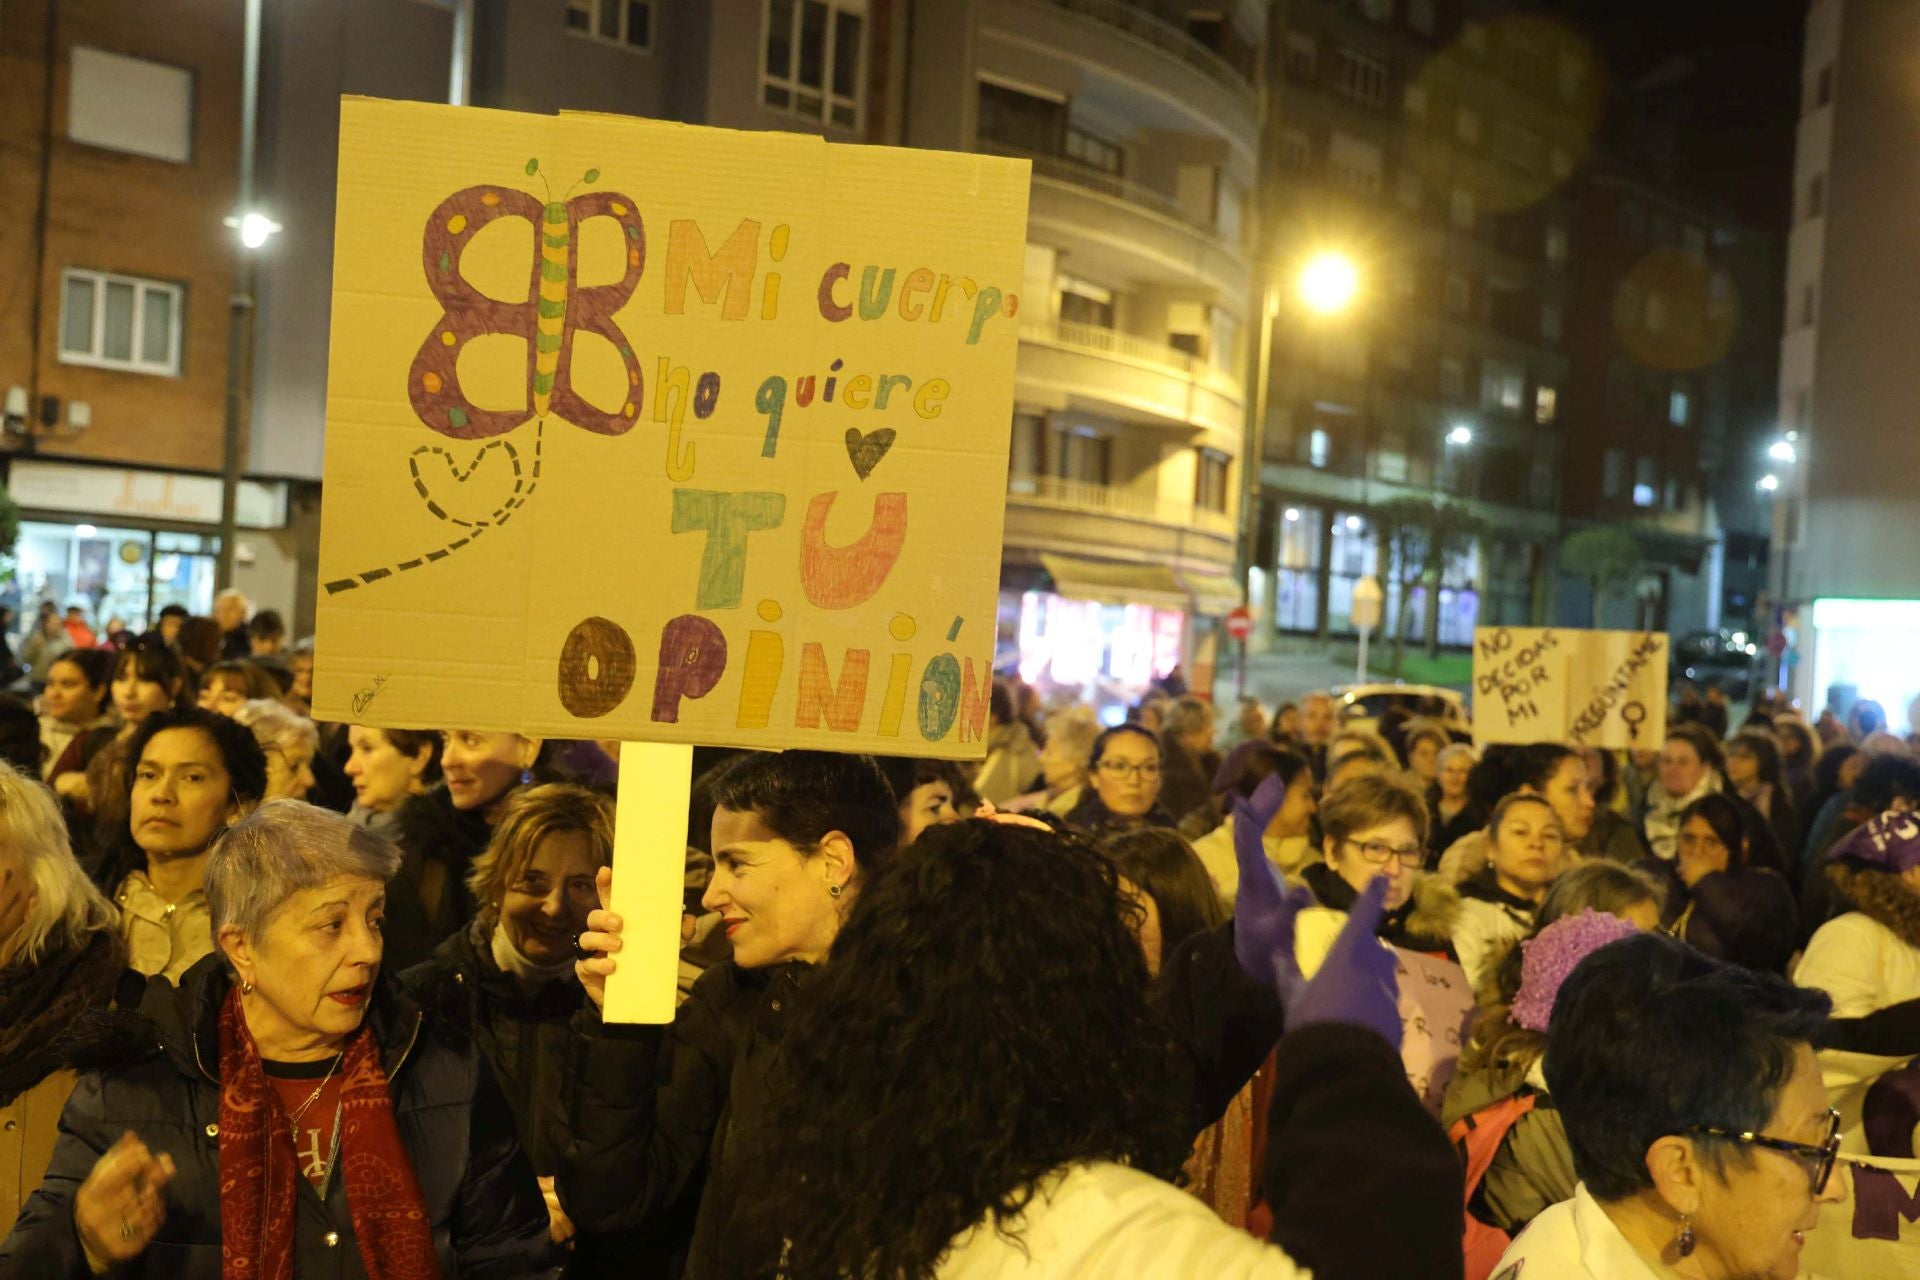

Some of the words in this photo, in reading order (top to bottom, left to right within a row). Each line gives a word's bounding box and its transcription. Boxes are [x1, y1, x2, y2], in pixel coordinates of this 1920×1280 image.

[664, 217, 791, 321] Mi
[816, 261, 1020, 345] cuerpo
[653, 356, 721, 481] no
[755, 357, 952, 459] quiere
[1479, 628, 1514, 659] NO
[1501, 665, 1549, 704] POR
[1507, 701, 1538, 727] MI
